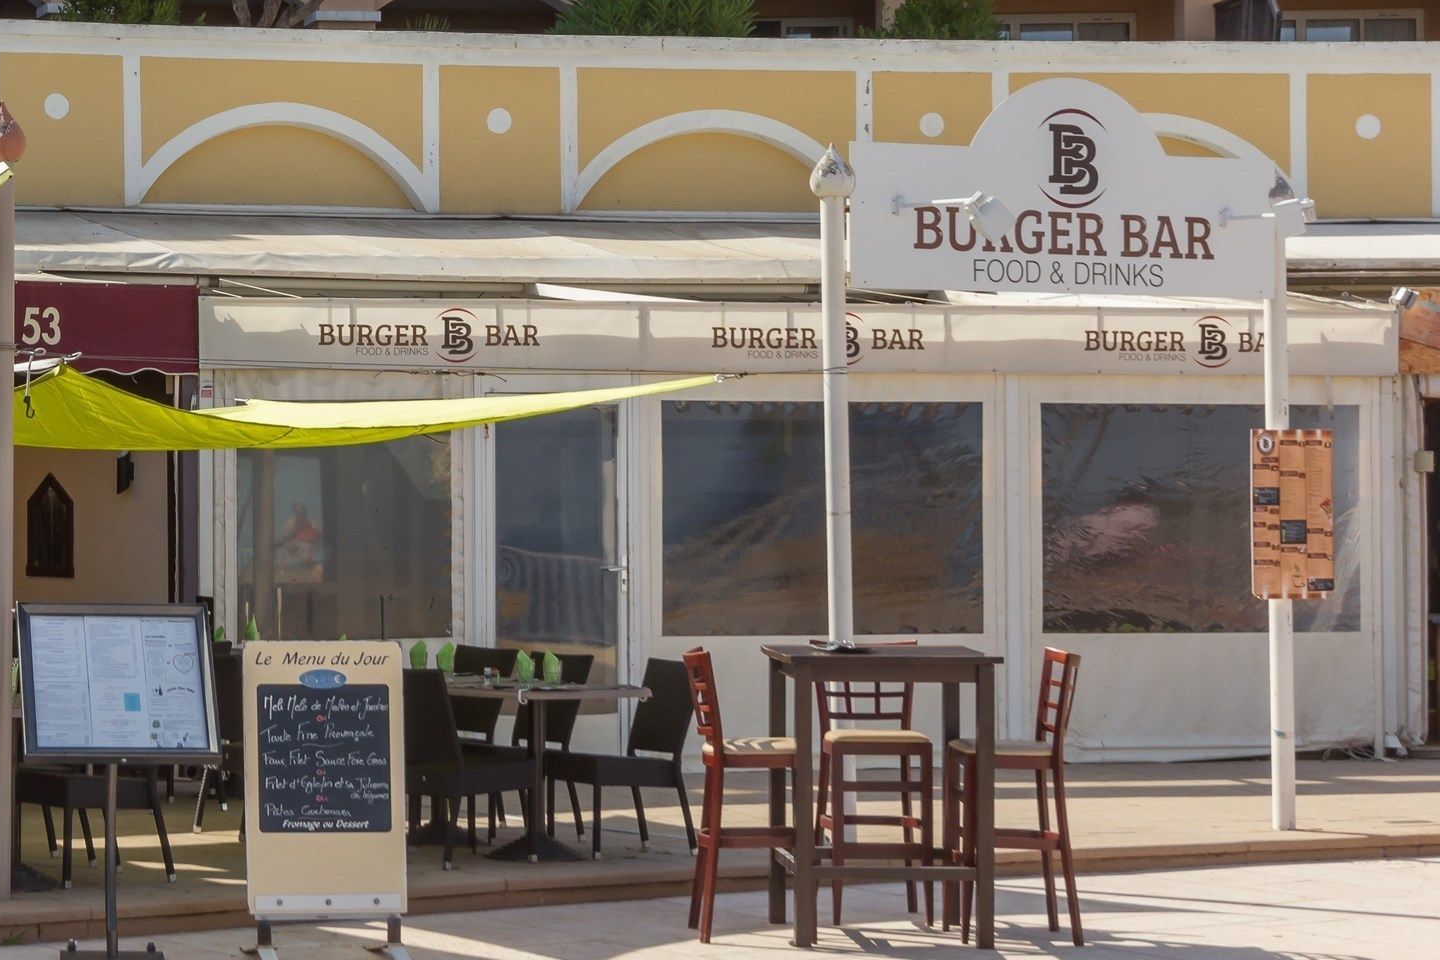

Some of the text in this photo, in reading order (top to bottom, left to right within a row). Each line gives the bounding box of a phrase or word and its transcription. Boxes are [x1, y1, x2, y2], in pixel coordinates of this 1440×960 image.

[1120, 213, 1215, 260] BAR
[973, 259, 1164, 288] FOOD & DRINKS
[21, 306, 62, 345] 53
[318, 323, 429, 347] BURGER
[484, 324, 540, 347] BAR
[711, 326, 818, 349] BURGER
[871, 328, 925, 351] BAR
[1084, 330, 1186, 352] BURGER
[1238, 331, 1264, 353] BA
[355, 346, 429, 356] FOOD & DRINKS
[747, 349, 818, 359] FOOD & DRINKS
[1119, 352, 1145, 362] FOOD
[1153, 352, 1186, 362] DRINKS
[255, 651, 390, 666] Le Menu du Jour
[260, 724, 292, 743] Tarte
[297, 721, 319, 740] Fine
[315, 750, 346, 767] Sauce
[282, 819, 370, 832] Fromage ou Dessert
